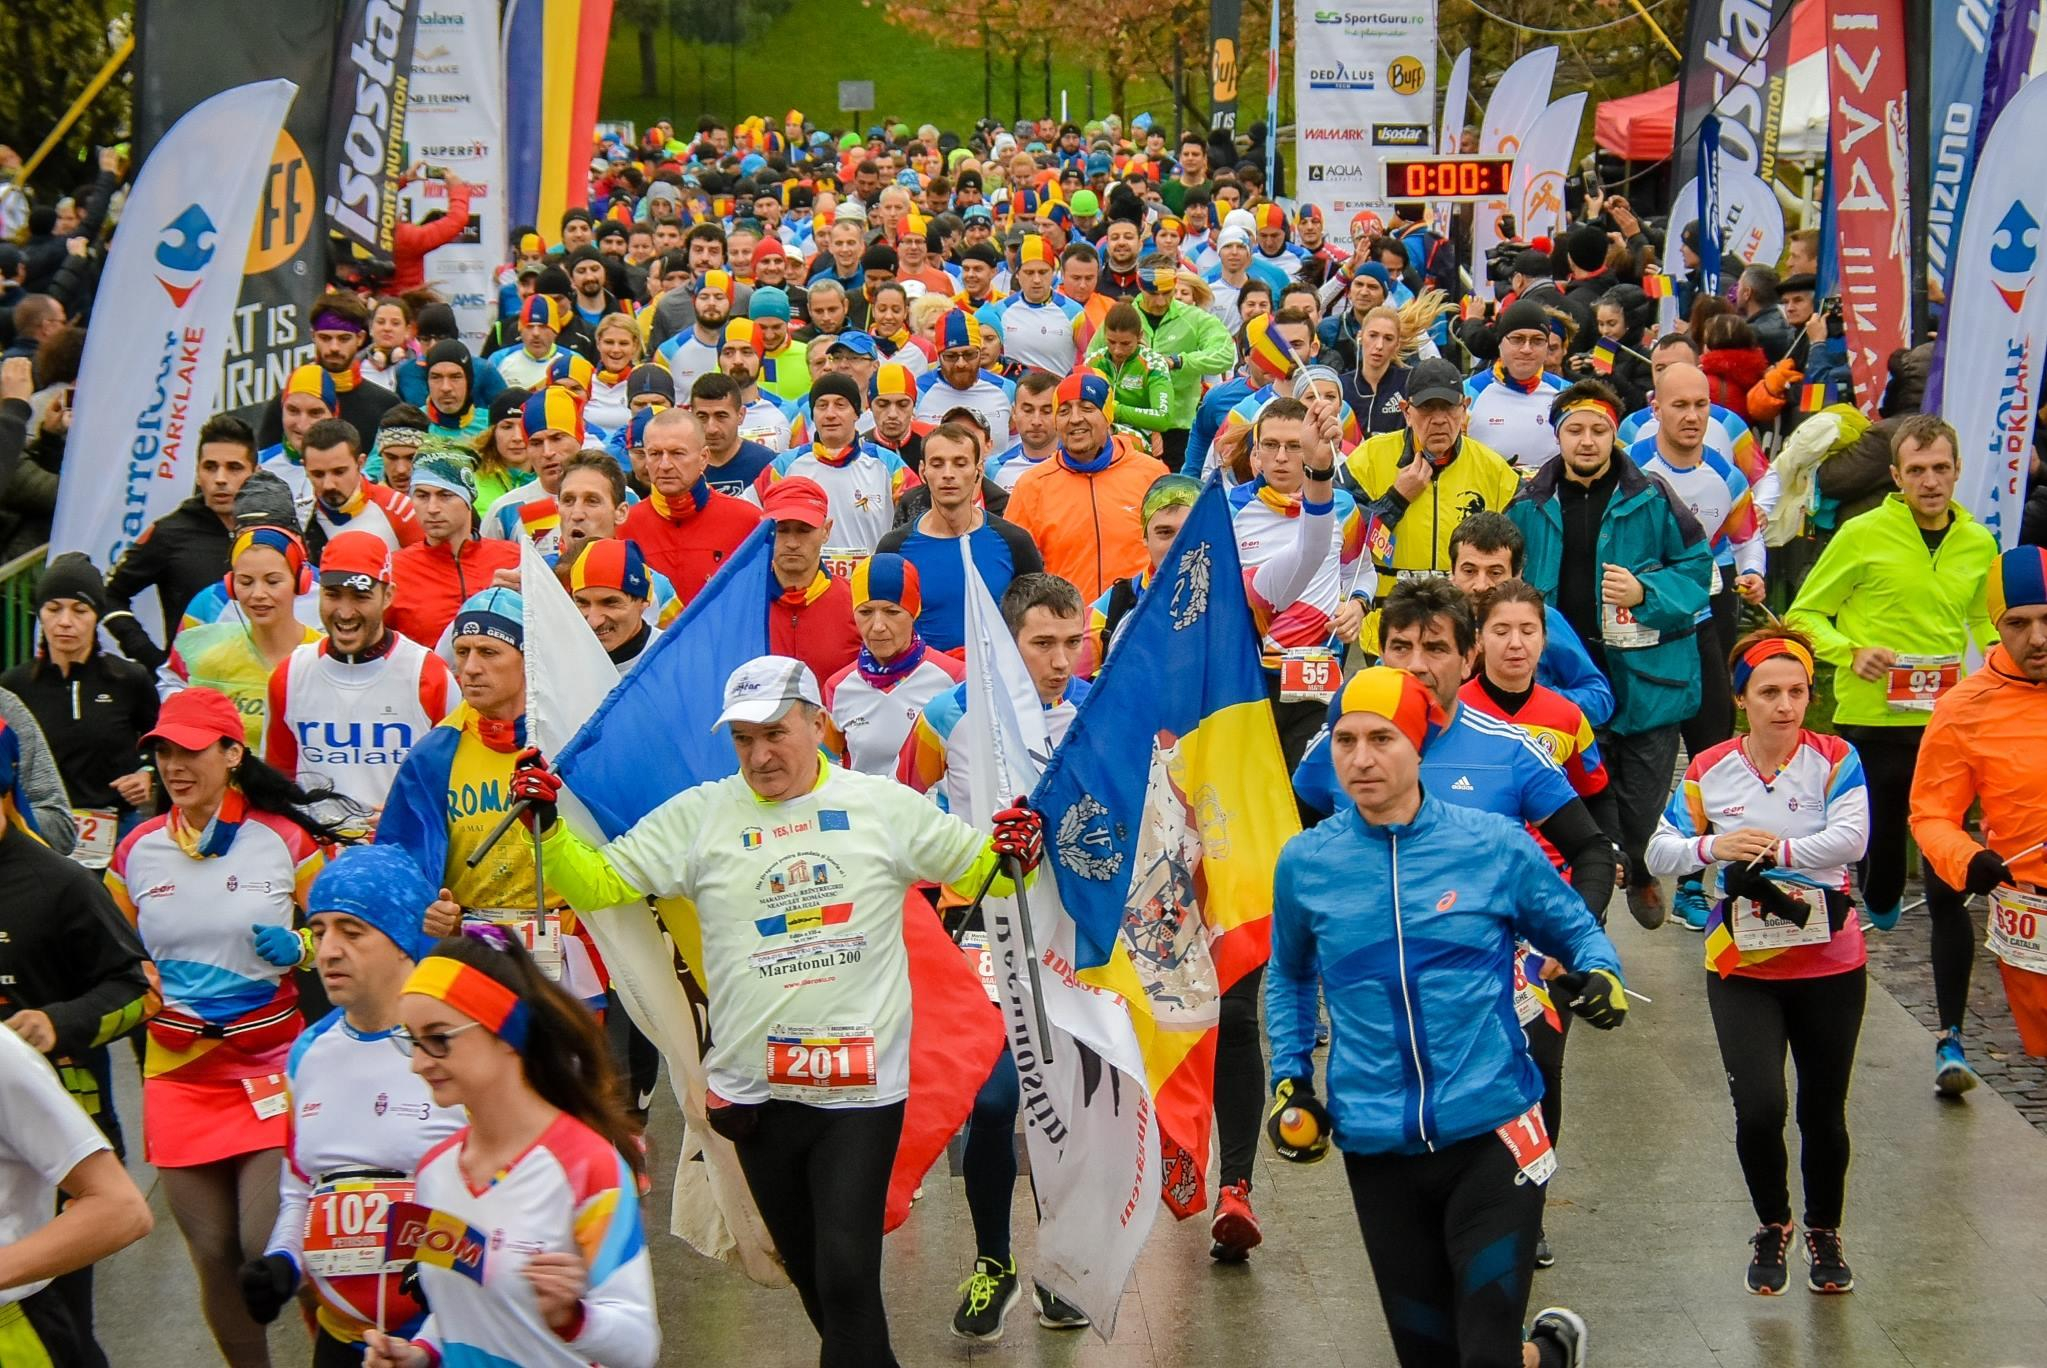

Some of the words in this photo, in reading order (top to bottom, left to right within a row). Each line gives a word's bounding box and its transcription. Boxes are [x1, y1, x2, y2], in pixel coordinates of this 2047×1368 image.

[1344, 13, 1424, 26] SportGuru.ro
[410, 65, 459, 73] RKLAKE
[325, 0, 406, 244] isosta
[386, 75, 408, 179] NUTRITION
[1305, 128, 1364, 140] WALMARK
[1761, 76, 1785, 182] NUTRITION
[1326, 165, 1362, 176] AQUA
[261, 160, 304, 251] FF
[267, 304, 297, 348] IS
[158, 326, 206, 480] PARKLAKE
[1370, 528, 1394, 558] ROM
[1301, 661, 1330, 685] 55
[1908, 671, 1942, 693] 93
[297, 721, 412, 748] run
[302, 746, 410, 765] Galat
[795, 823, 808, 834] can
[1764, 919, 1794, 928] BOGDA
[760, 954, 835, 979] Maratonul
[839, 950, 861, 965] 200
[768, 1046, 776, 1077] MARATON
[787, 1046, 850, 1079] 201
[321, 1192, 390, 1235] 102
[397, 1221, 483, 1269] ROM
